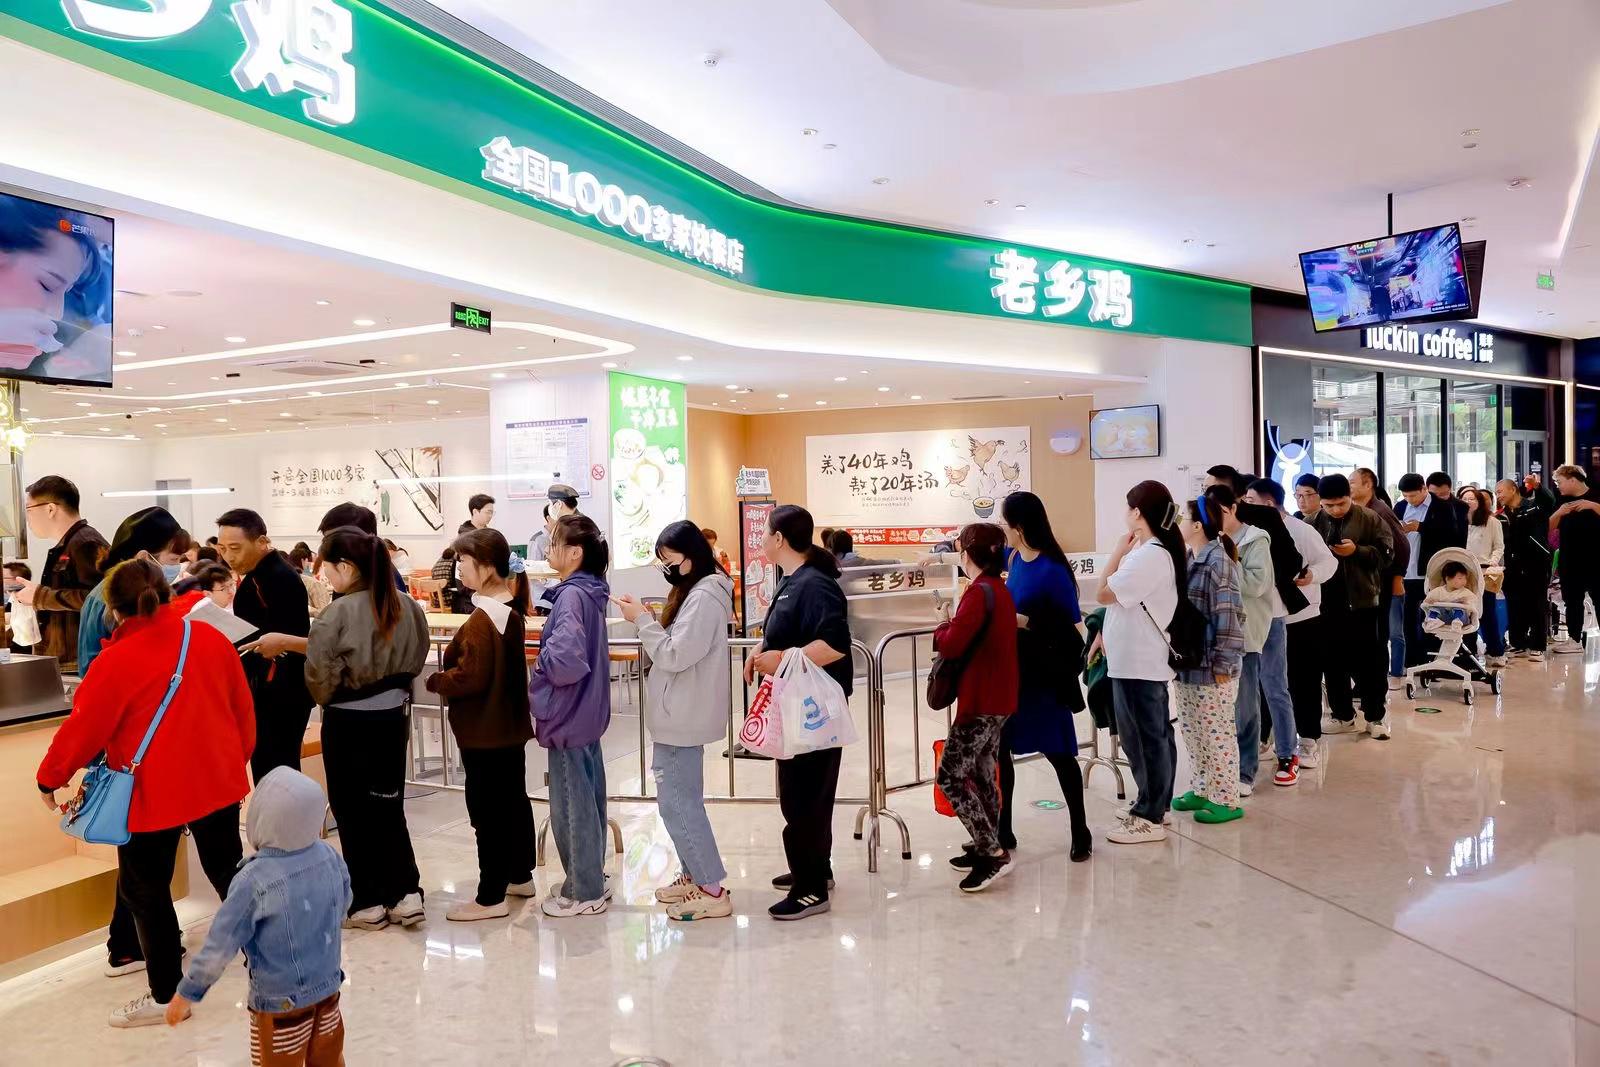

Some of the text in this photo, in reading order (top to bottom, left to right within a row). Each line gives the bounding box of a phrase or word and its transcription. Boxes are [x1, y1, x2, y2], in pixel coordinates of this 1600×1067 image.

[480, 136, 744, 275] 全国1000多家快餐店
[990, 248, 1133, 328] 老乡鸡
[1366, 325, 1473, 361] luckin coffee
[820, 448, 913, 476] 养了40年鸡
[849, 470, 940, 497] 熬了20年汤
[868, 570, 926, 591] 老乡鸡
